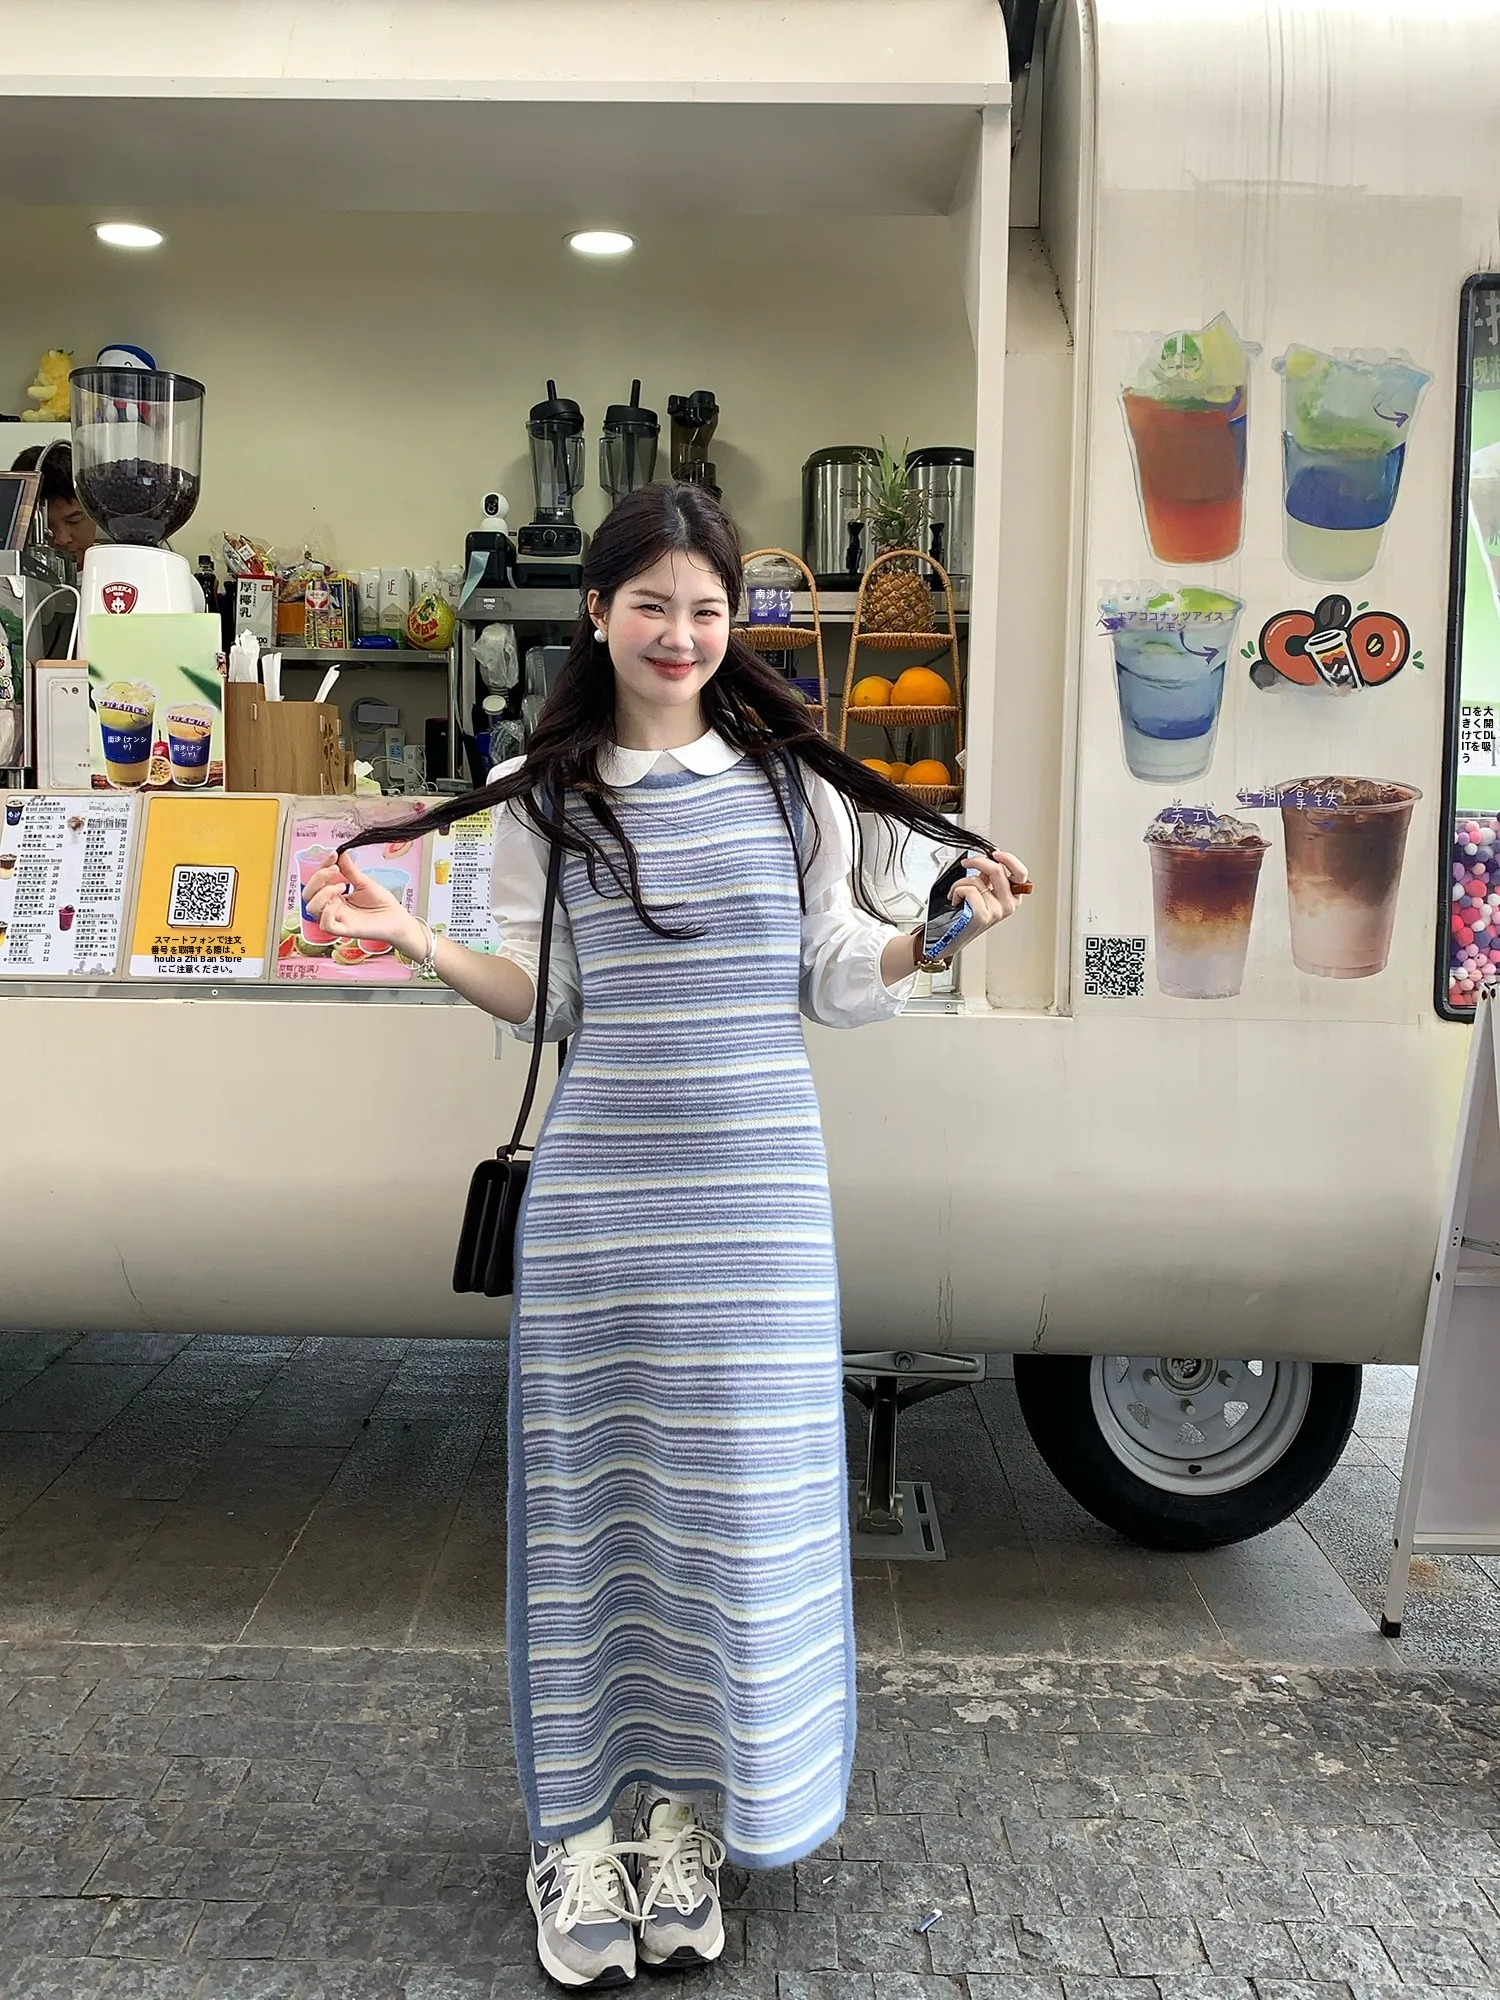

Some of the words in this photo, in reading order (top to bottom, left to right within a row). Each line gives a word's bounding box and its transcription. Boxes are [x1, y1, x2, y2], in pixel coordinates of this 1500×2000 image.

[1117, 612, 1224, 622] エアココナッツアイス
[1156, 622, 1186, 632] レモン
[1462, 718, 1494, 728] きく開
[1462, 730, 1496, 740] けてDL
[1462, 742, 1492, 752] ITを吸
[1462, 753, 1470, 764] う
[154, 936, 242, 944] スマートフォンで注文
[158, 965, 232, 973] にご注意ください。
